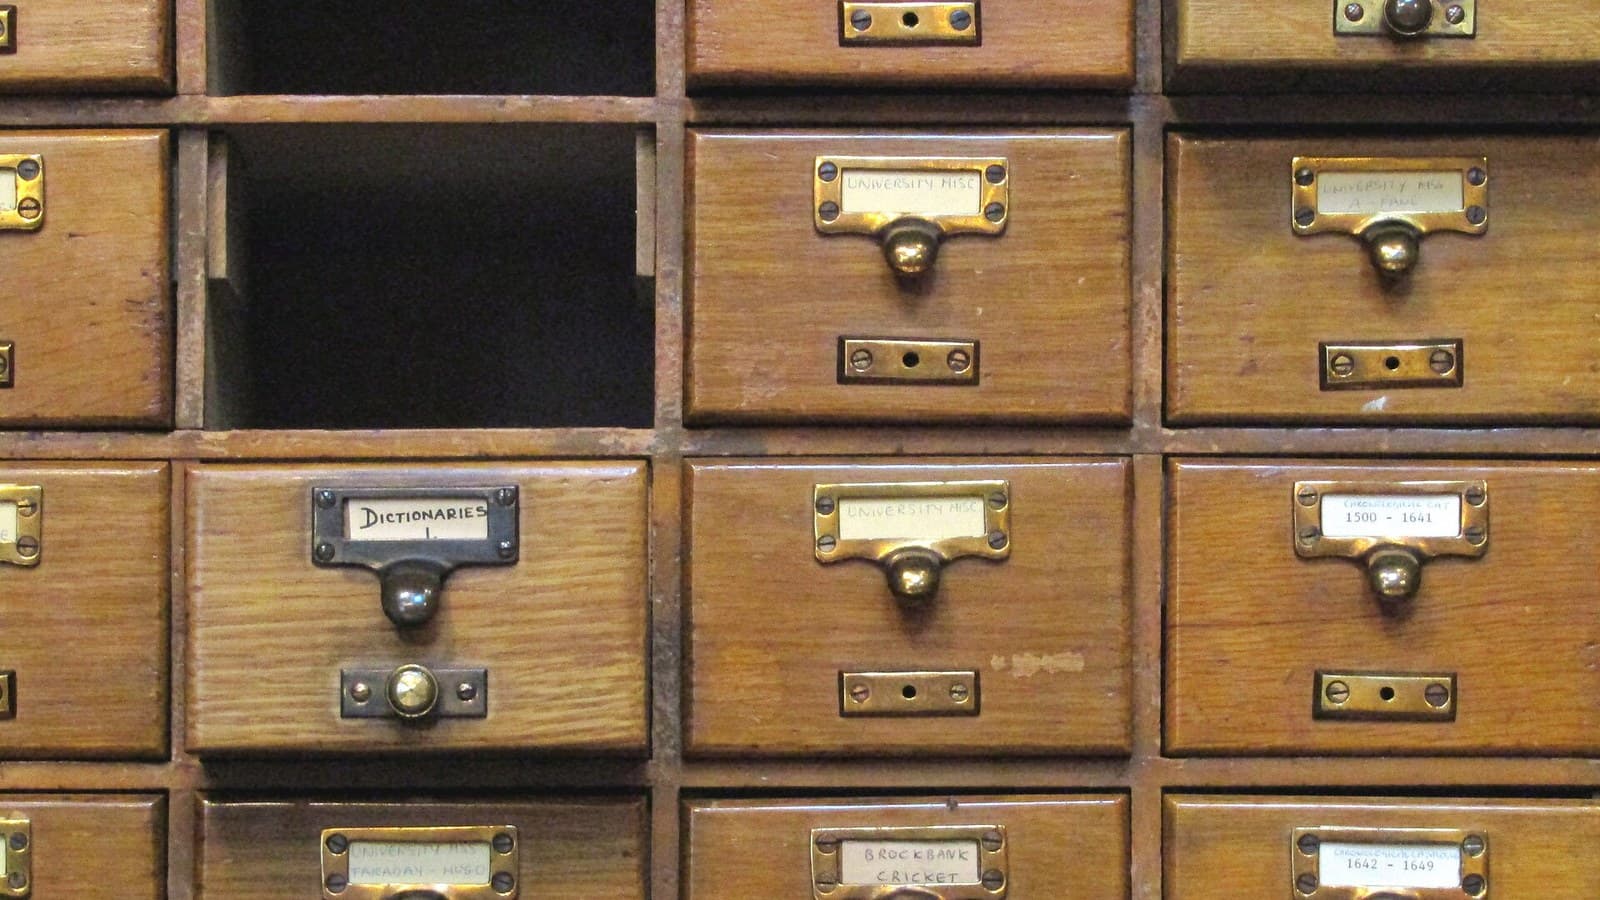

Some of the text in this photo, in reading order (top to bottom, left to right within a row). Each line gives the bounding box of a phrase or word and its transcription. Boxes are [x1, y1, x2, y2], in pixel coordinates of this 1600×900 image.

[847, 176, 976, 190] UNIVERSITY MISC
[359, 505, 488, 529] DICTIONARIES
[847, 503, 943, 518] UNIVERSITY
[1346, 512, 1377, 523] 1500
[1402, 512, 1433, 523] 1641
[864, 848, 969, 861] BROCKBANK
[1347, 858, 1378, 870] 1642
[1403, 860, 1434, 871] 1649
[876, 871, 959, 883] CRICKET
